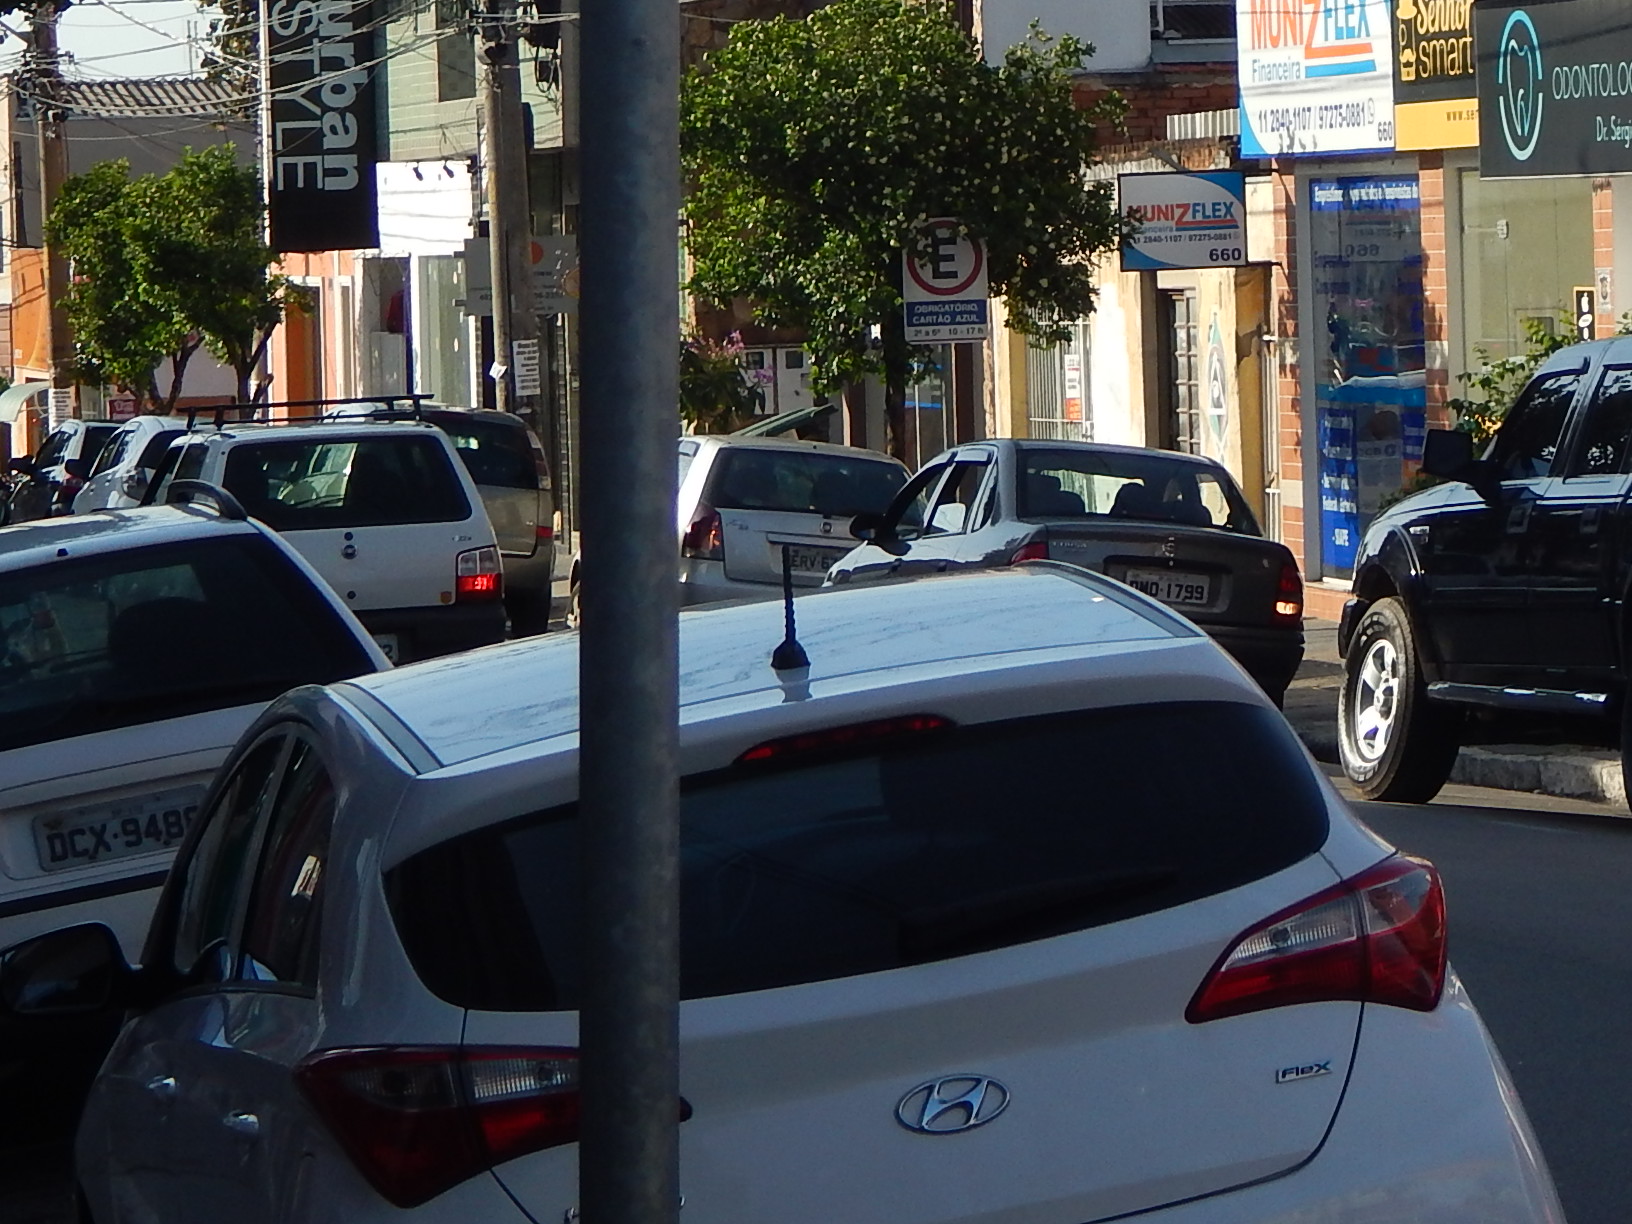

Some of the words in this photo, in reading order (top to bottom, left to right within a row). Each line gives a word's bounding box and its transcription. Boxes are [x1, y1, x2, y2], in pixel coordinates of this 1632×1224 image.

[1252, 56, 1300, 82] Financeira
[1418, 36, 1474, 78] smart
[271, 0, 324, 191] STYLE
[318, 0, 369, 191] urban
[1259, 110, 1268, 133] 11
[1270, 107, 1312, 133] 2840-1107
[1318, 101, 1366, 130] 97275-0881
[1597, 116, 1609, 141] Dr.
[1377, 121, 1393, 141] 660
[931, 236, 958, 279] E
[1209, 247, 1242, 262] 660
[913, 314, 951, 325] CARTÃO
[955, 314, 979, 322] AZUL
[914, 302, 978, 314] OBRIGATÓRIO
